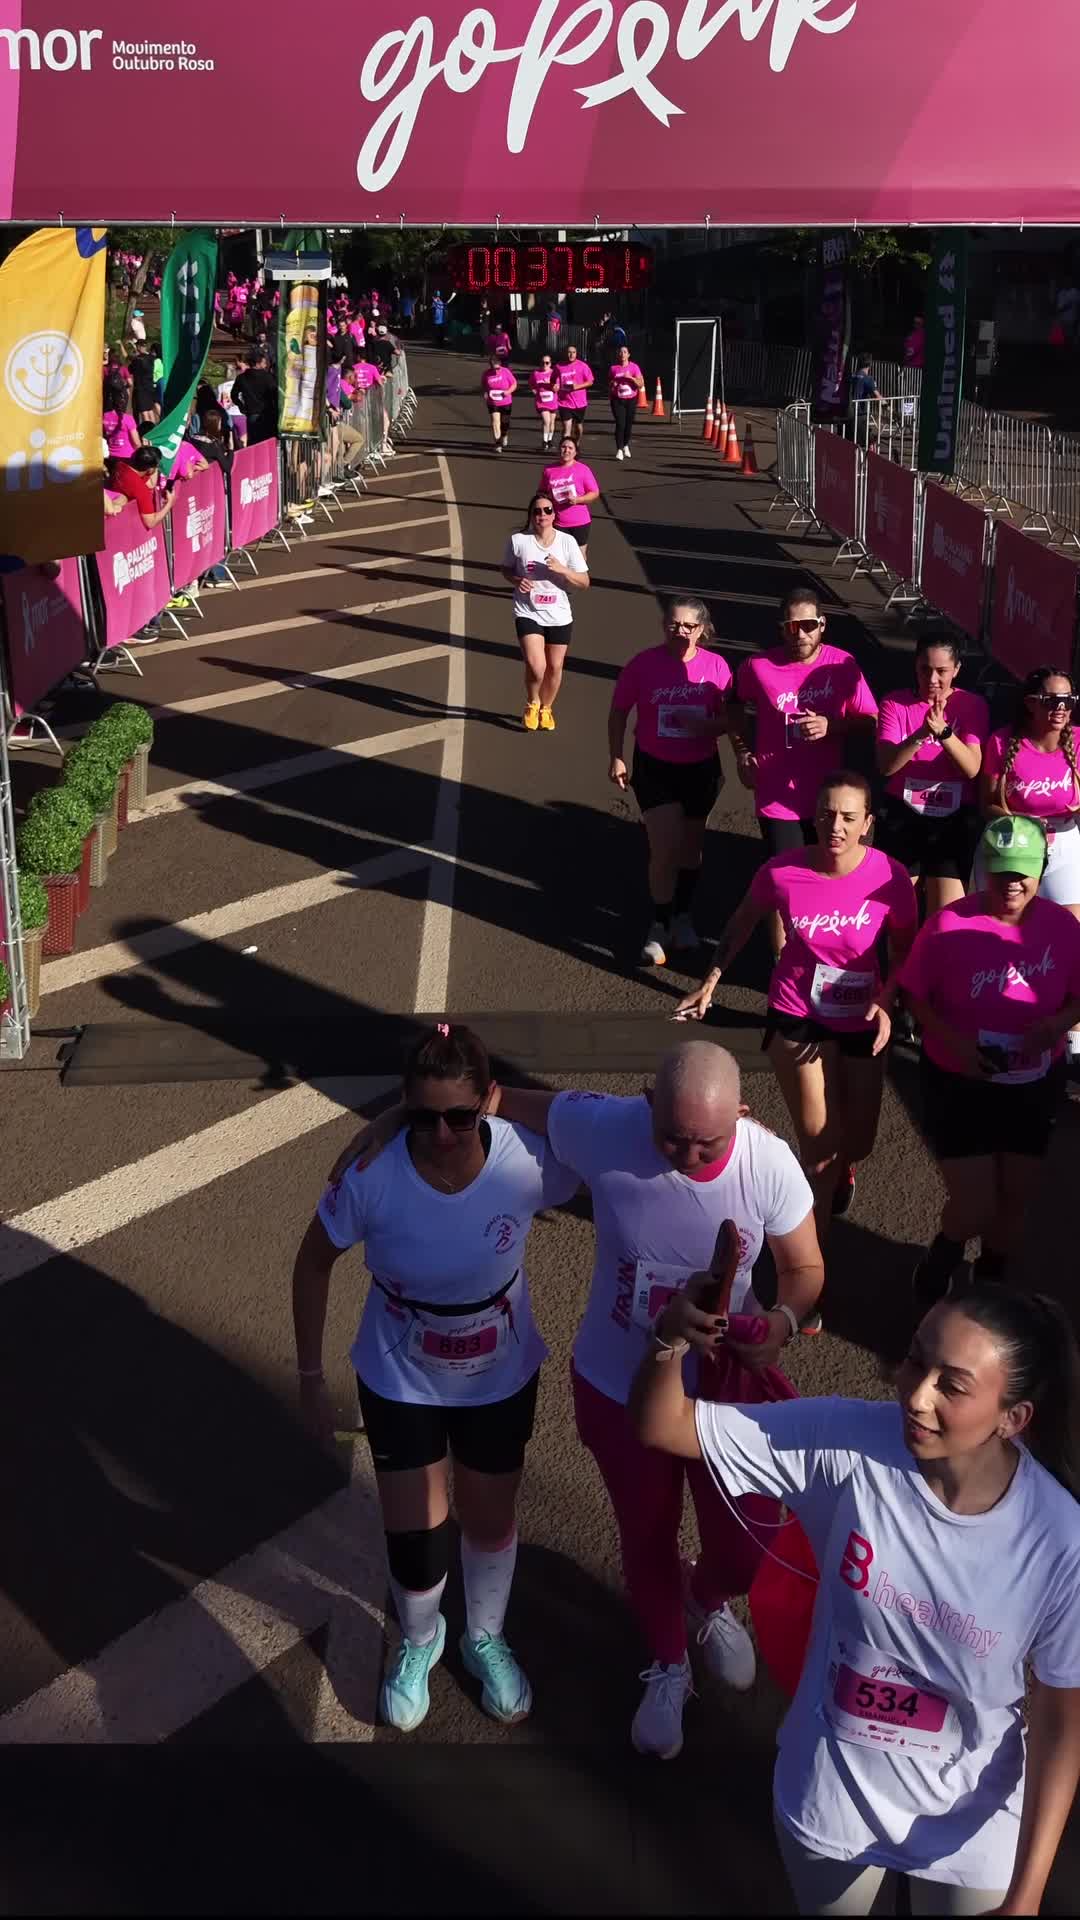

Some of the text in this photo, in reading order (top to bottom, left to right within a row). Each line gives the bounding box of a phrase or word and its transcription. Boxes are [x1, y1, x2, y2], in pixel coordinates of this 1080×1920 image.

[112, 40, 196, 54] Movimento
[112, 56, 214, 71] Outubro Rosa
[126, 536, 158, 568] PALHANO
[969, 943, 1057, 1000] gopink
[439, 1336, 481, 1354] 883
[855, 1681, 919, 1718] 534
